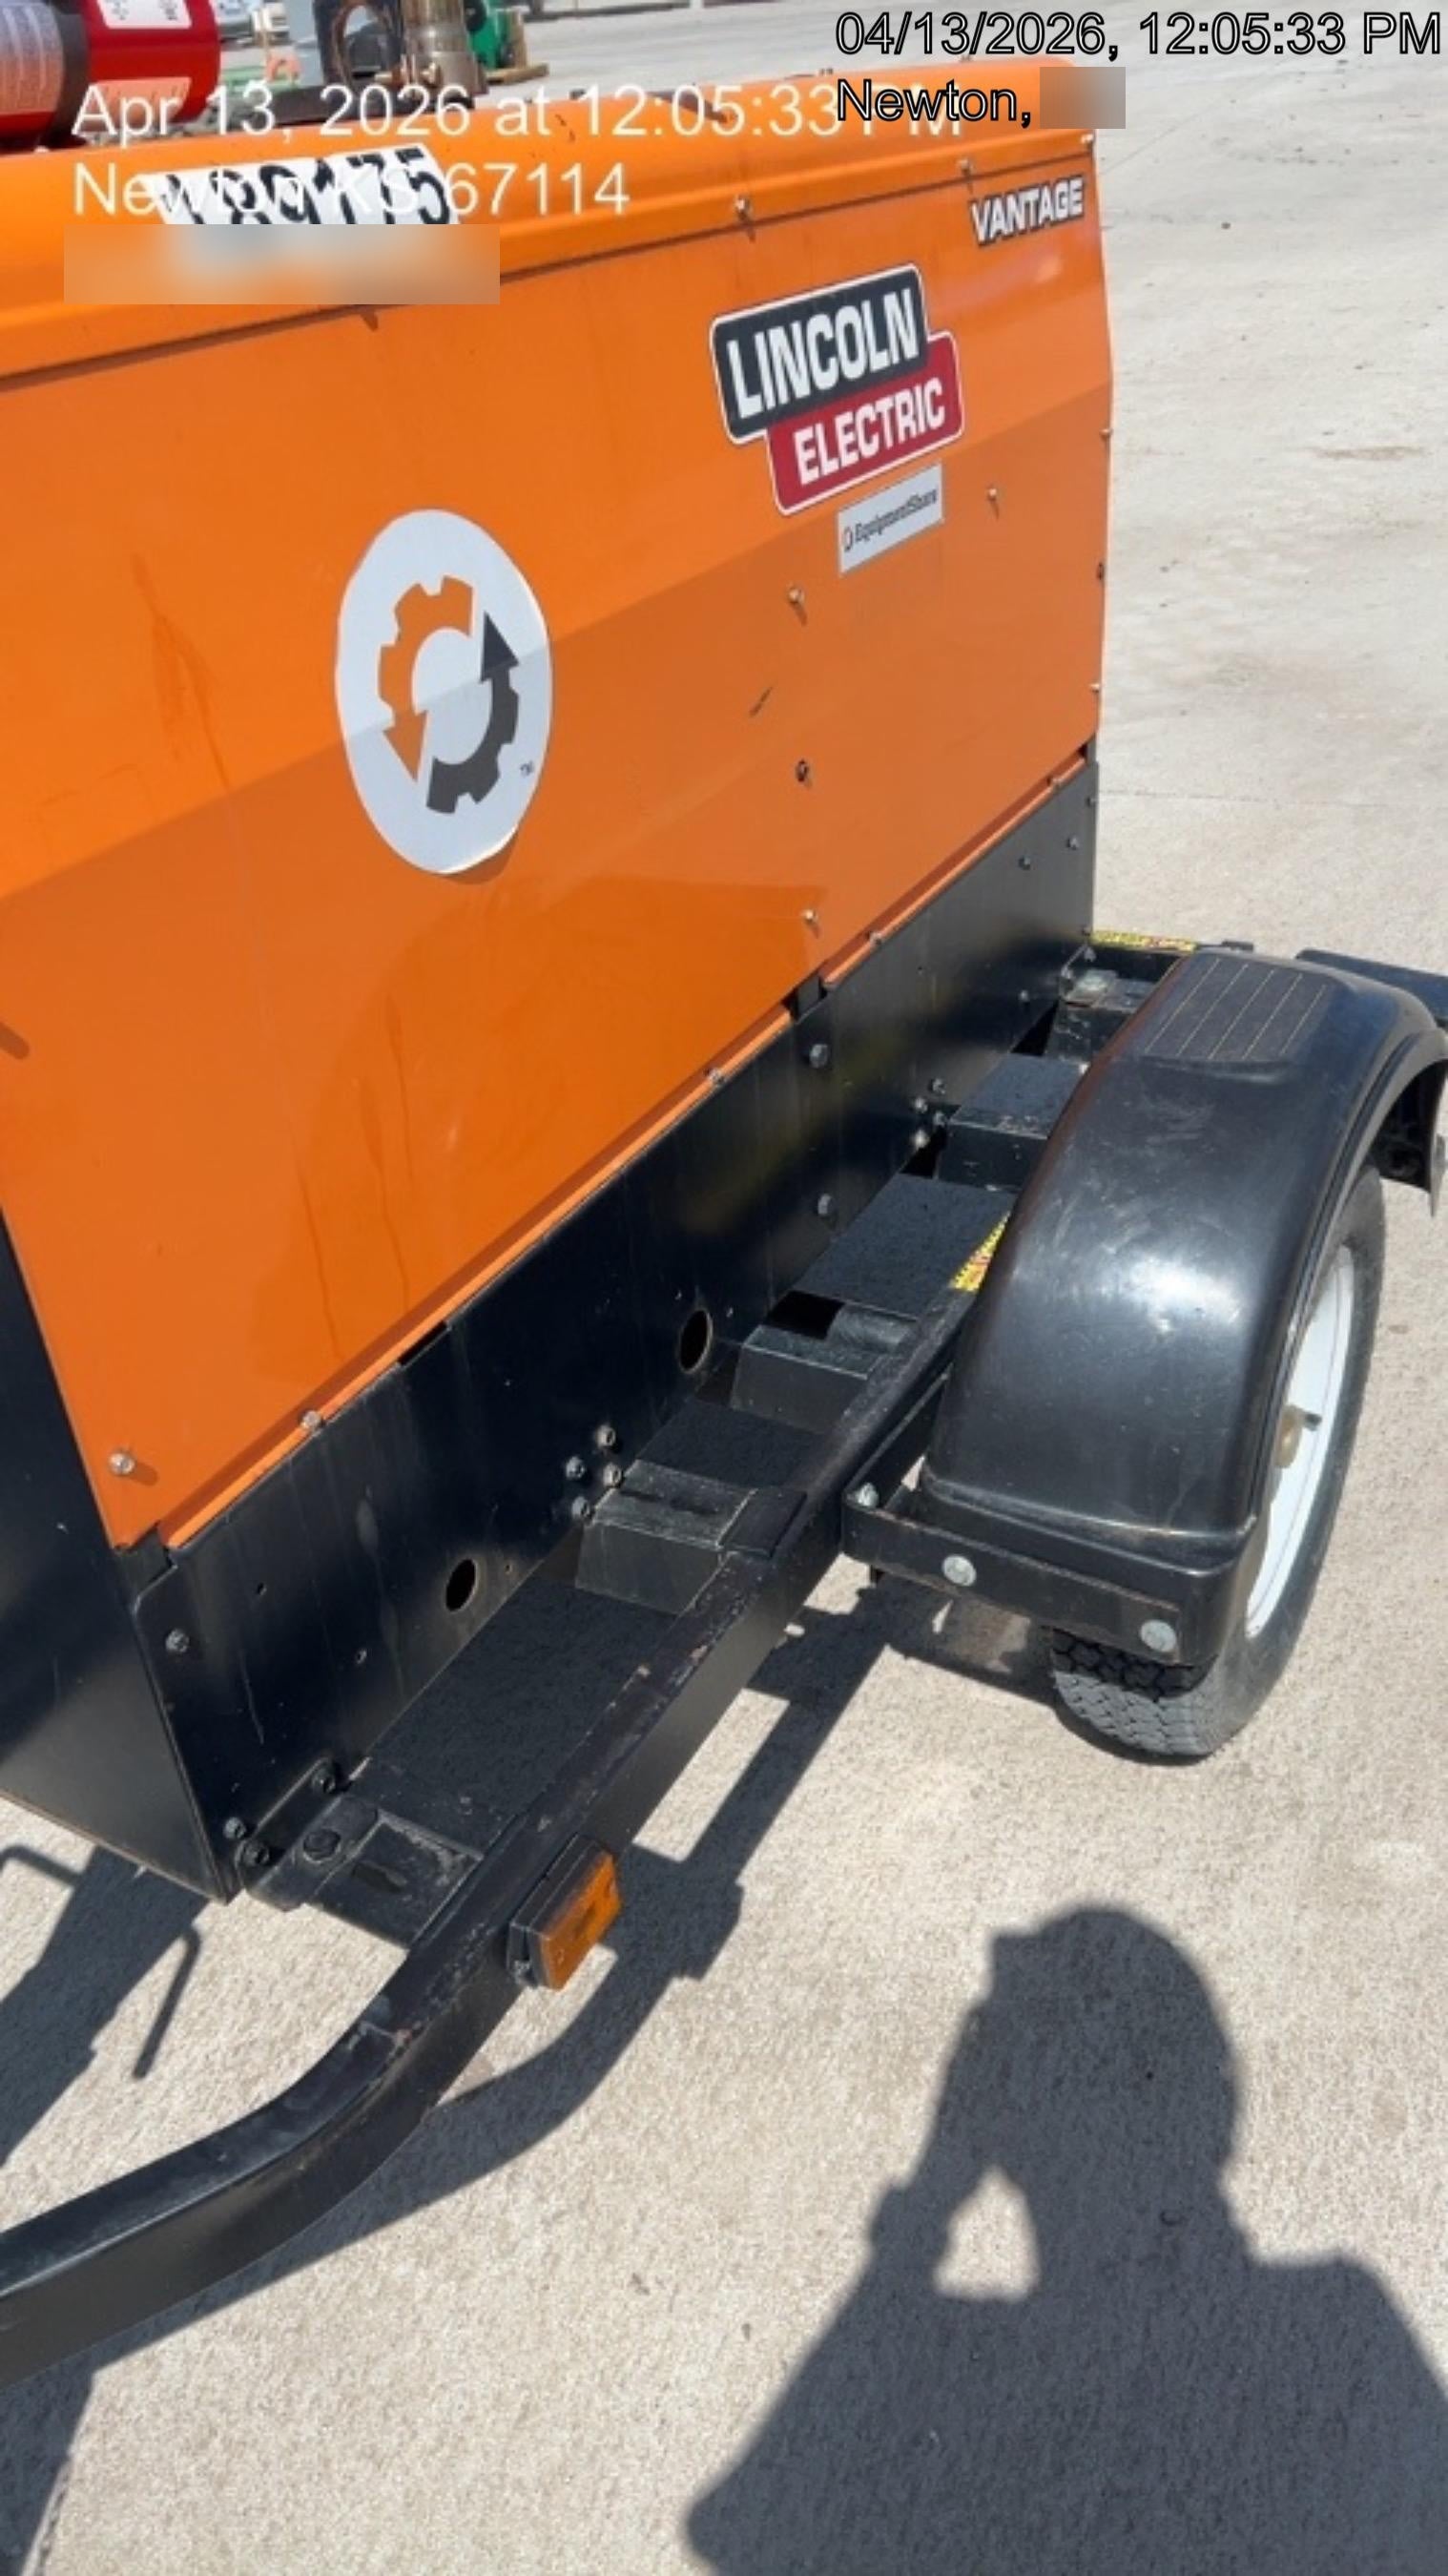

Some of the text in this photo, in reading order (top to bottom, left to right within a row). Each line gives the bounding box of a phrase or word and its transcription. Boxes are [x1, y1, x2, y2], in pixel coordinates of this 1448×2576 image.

[970, 175, 1085, 246] VANTAGE
[726, 288, 921, 419] LINCOLN
[794, 377, 945, 487] ELECTRIC
